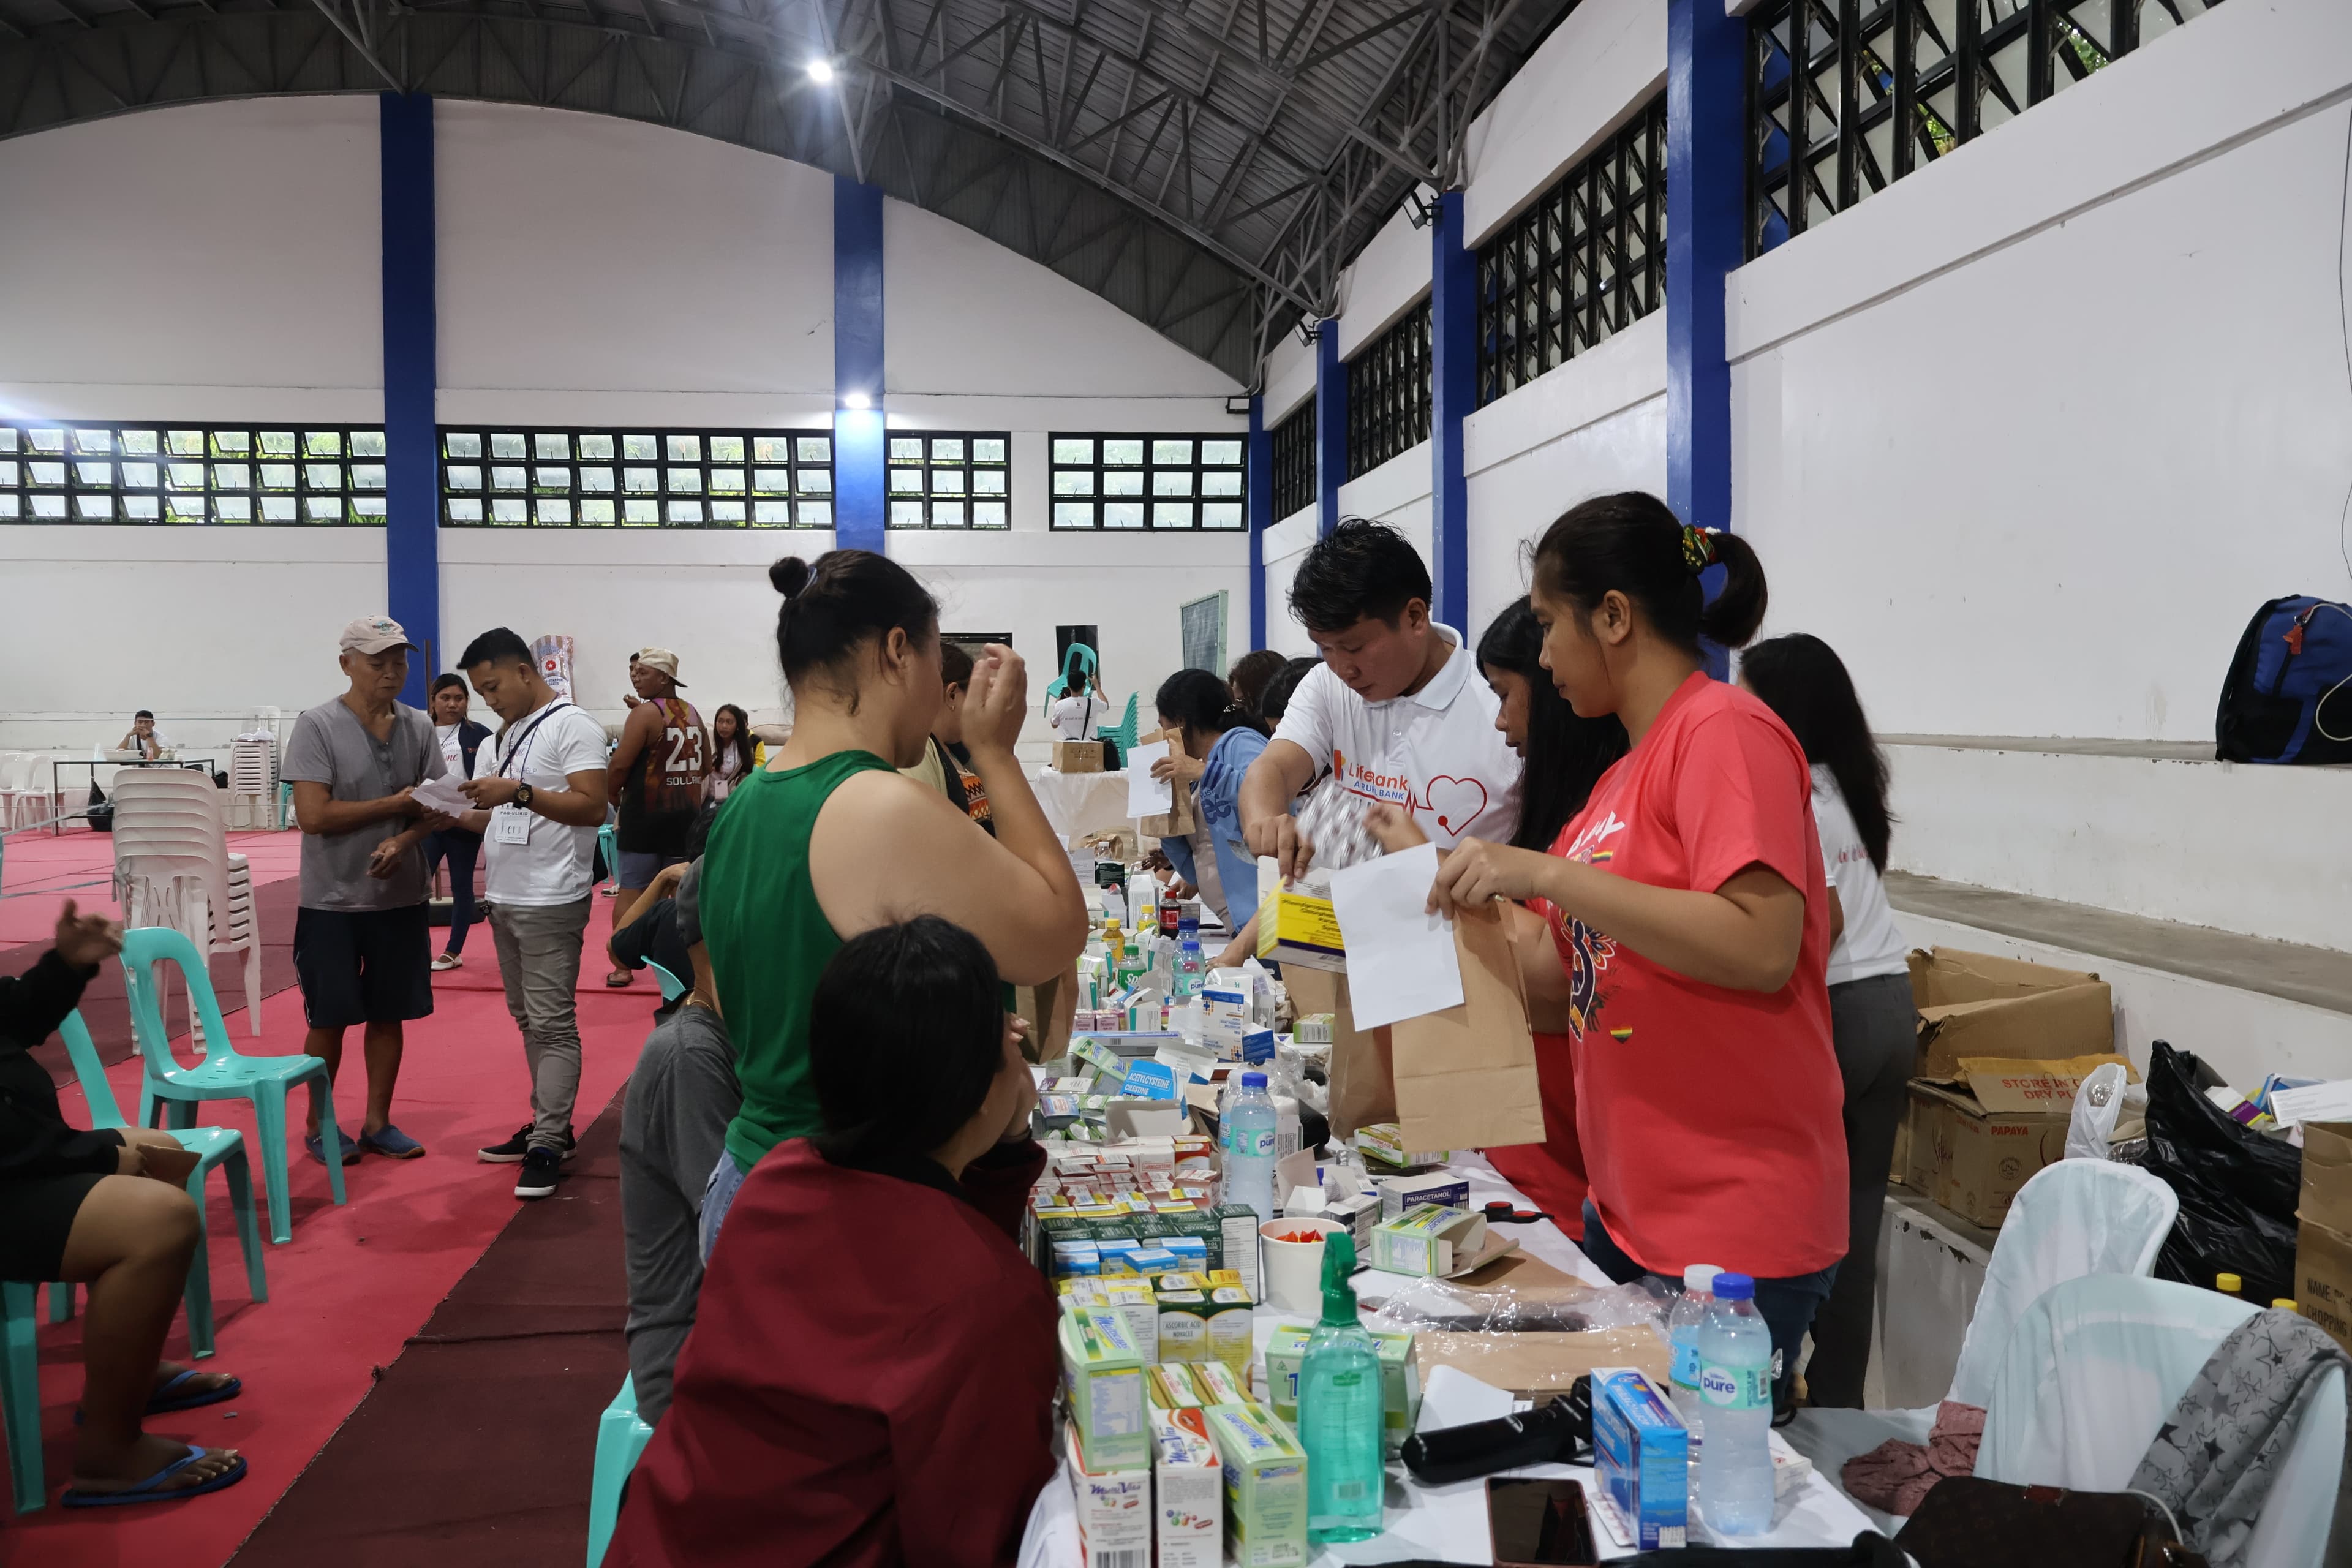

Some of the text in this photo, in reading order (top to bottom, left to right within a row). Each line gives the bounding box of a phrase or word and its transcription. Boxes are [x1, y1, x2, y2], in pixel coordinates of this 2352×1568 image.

[665, 726, 703, 772] 23
[1349, 762, 1408, 791] Lifeank
[1379, 788, 1404, 800] BANK
[1128, 1072, 1170, 1090] ACETYLCYSTEINE
[2002, 1079, 2051, 1088] STORE
[2052, 1079, 2068, 1088] IN
[2023, 1090, 2075, 1099] DRY PL
[1991, 1126, 2029, 1136] PAPAYA
[1406, 1191, 1451, 1204] PARACETAMOL
[1703, 1376, 1735, 1393] pure
